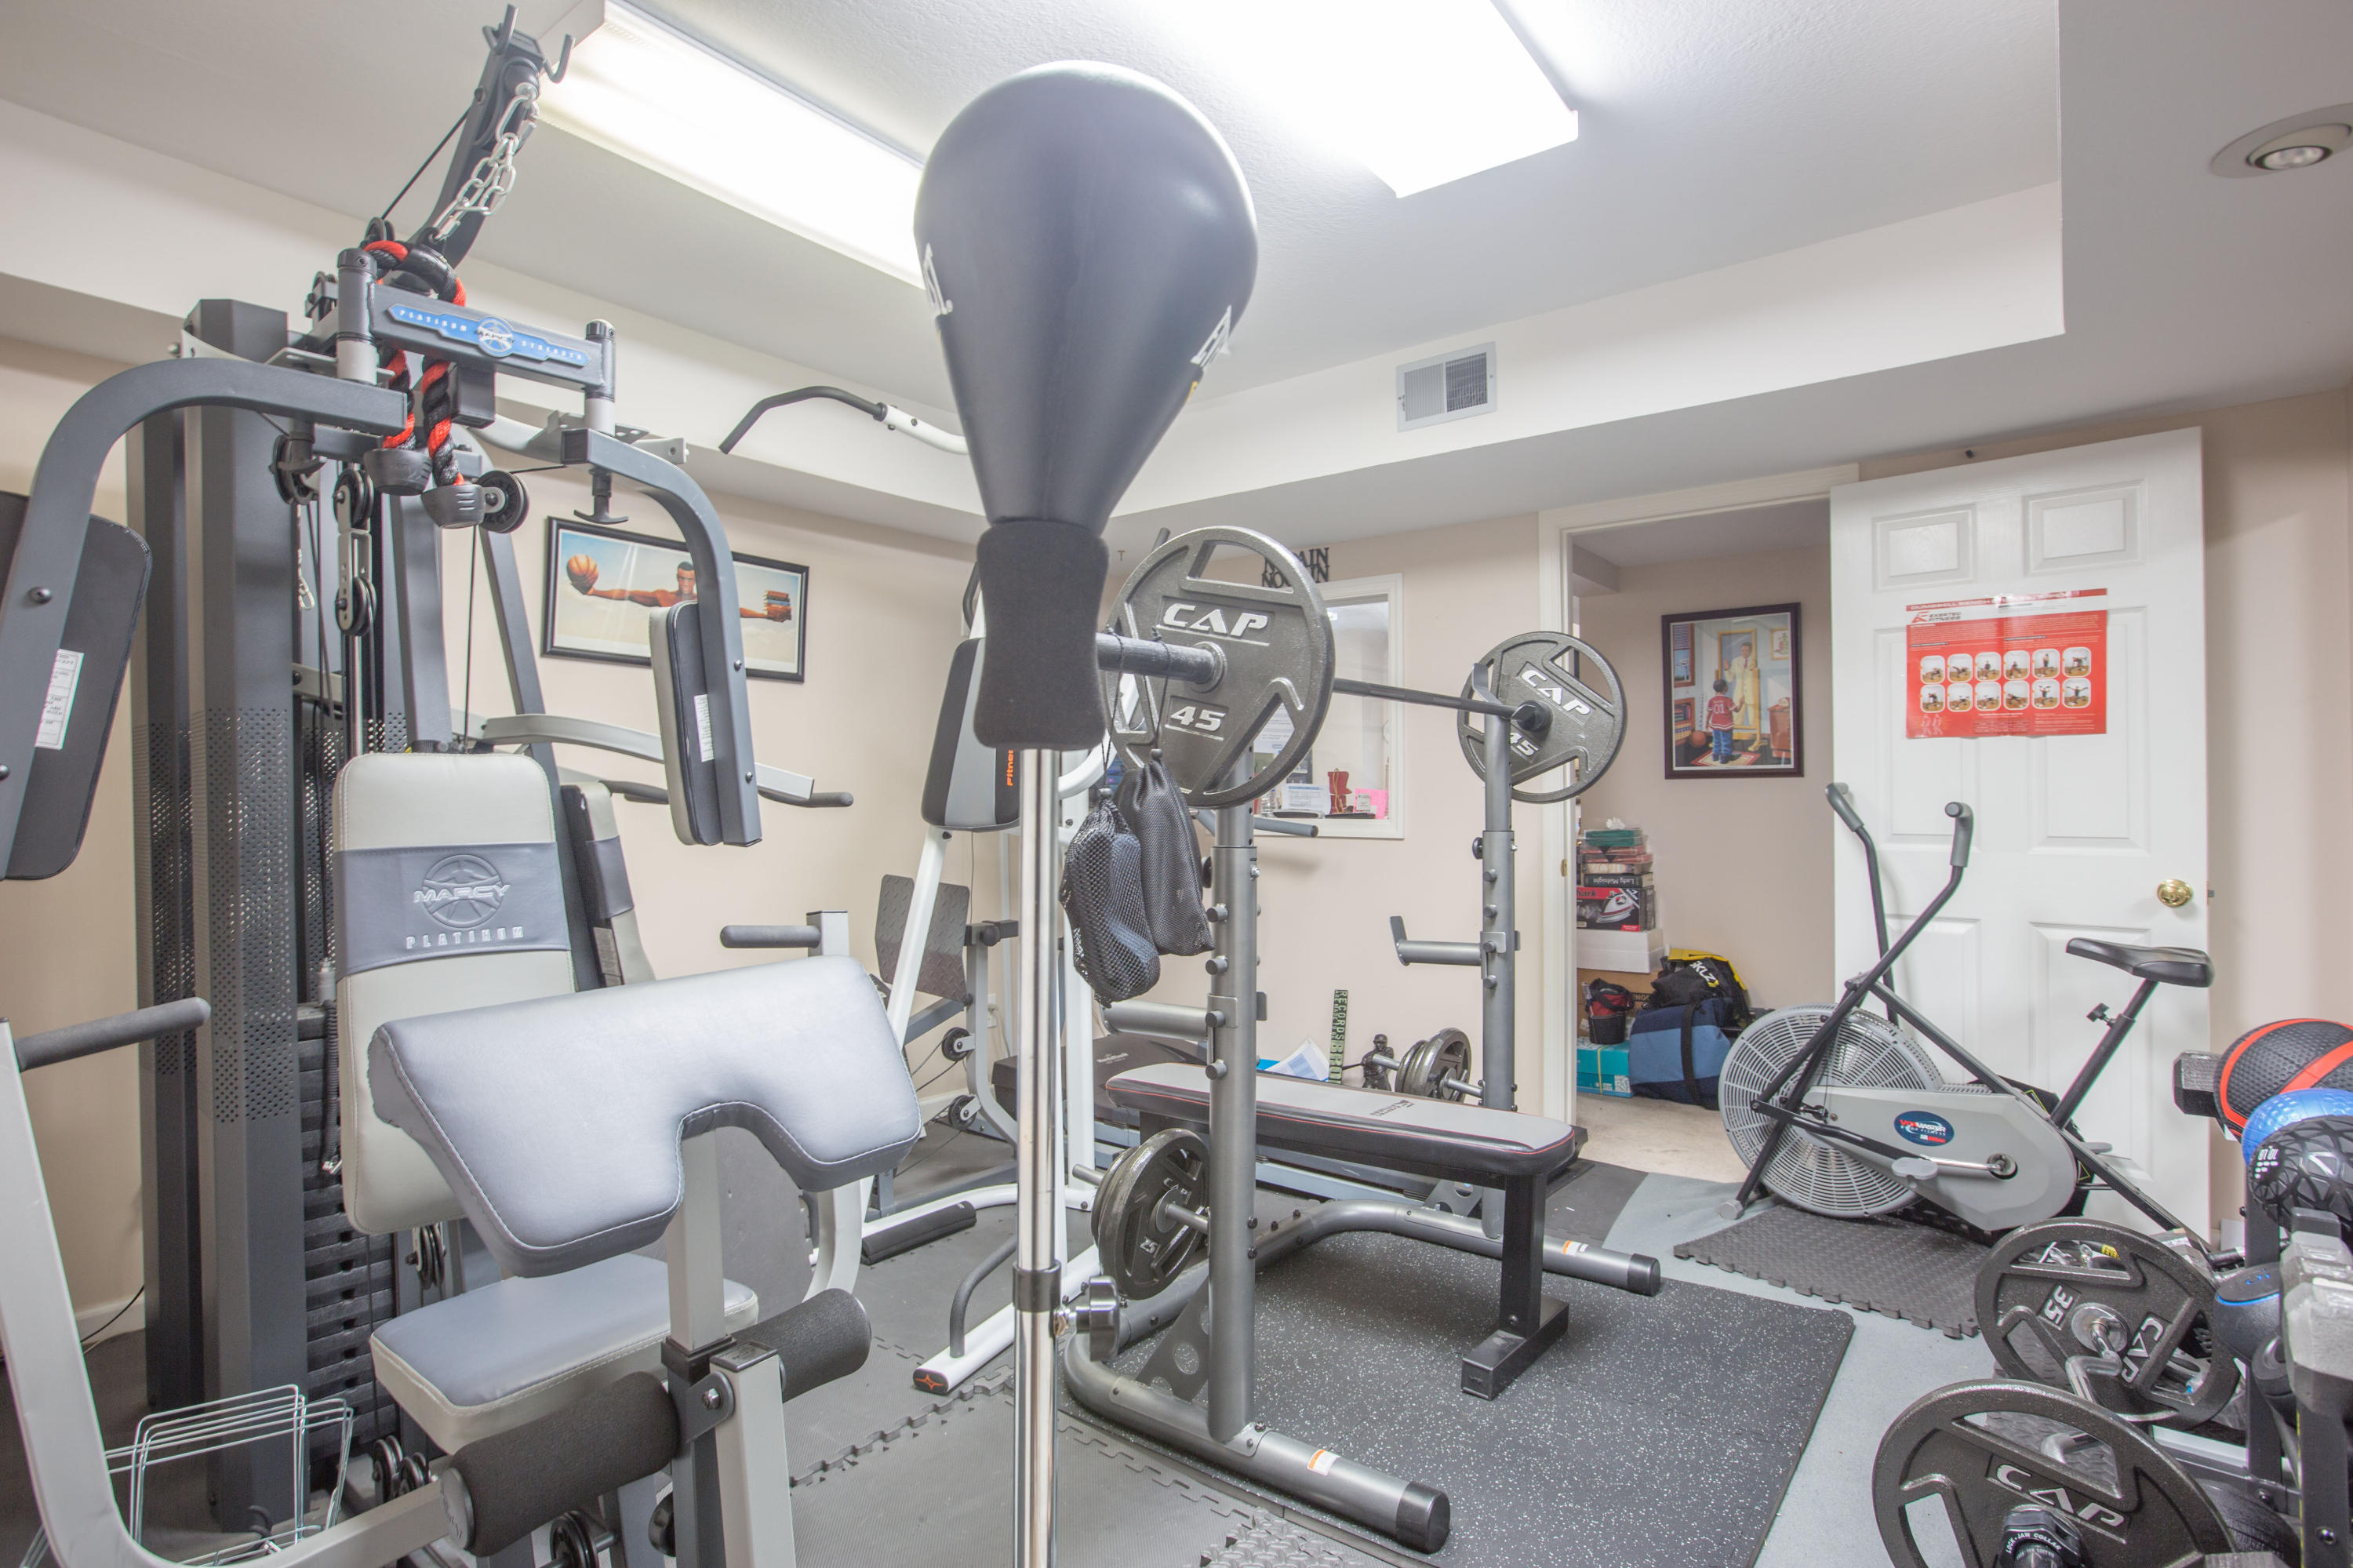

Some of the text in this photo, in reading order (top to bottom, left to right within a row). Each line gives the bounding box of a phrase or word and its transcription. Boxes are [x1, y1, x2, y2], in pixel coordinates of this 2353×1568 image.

[1162, 602, 1269, 638] CAP
[1522, 669, 1591, 715] CAP
[1170, 705, 1226, 732] 45
[413, 884, 511, 903] MARCY
[406, 926, 524, 950] PLATINUM
[1336, 989, 1348, 1040] RECORDS
[1329, 1040, 1344, 1084] BRO
[1140, 1237, 1158, 1254] 25
[2044, 1285, 2075, 1325] 35
[2120, 1317, 2164, 1384] CAP
[1996, 1464, 2125, 1527] CAP
[2033, 1533, 2062, 1550] COLLAR
